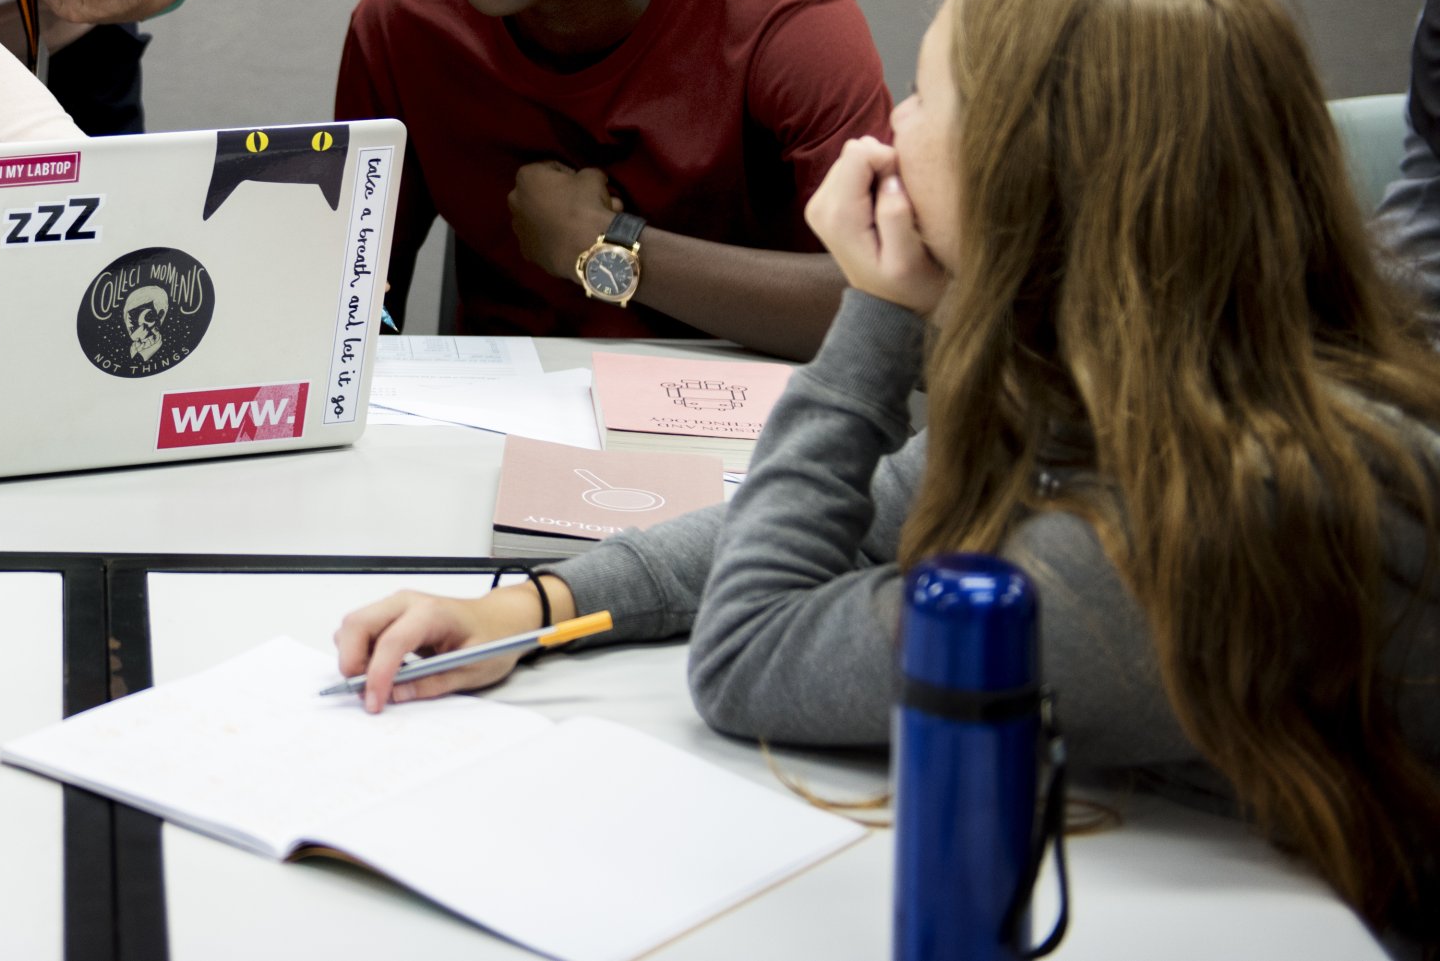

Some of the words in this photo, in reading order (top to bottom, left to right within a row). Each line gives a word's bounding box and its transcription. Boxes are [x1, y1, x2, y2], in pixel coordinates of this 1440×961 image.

[6, 165, 25, 178] MY
[27, 161, 71, 177] LABTOP
[365, 158, 382, 200] take
[360, 207, 372, 221] a
[350, 228, 374, 288] breath
[345, 295, 365, 331] and
[94, 353, 121, 372] NOT
[129, 346, 190, 374] THINGS
[341, 338, 362, 364] let
[338, 370, 356, 387] it
[330, 395, 345, 419] go
[649, 416, 763, 427] ECHNOLOGY
[702, 425, 763, 434] ESIGN
